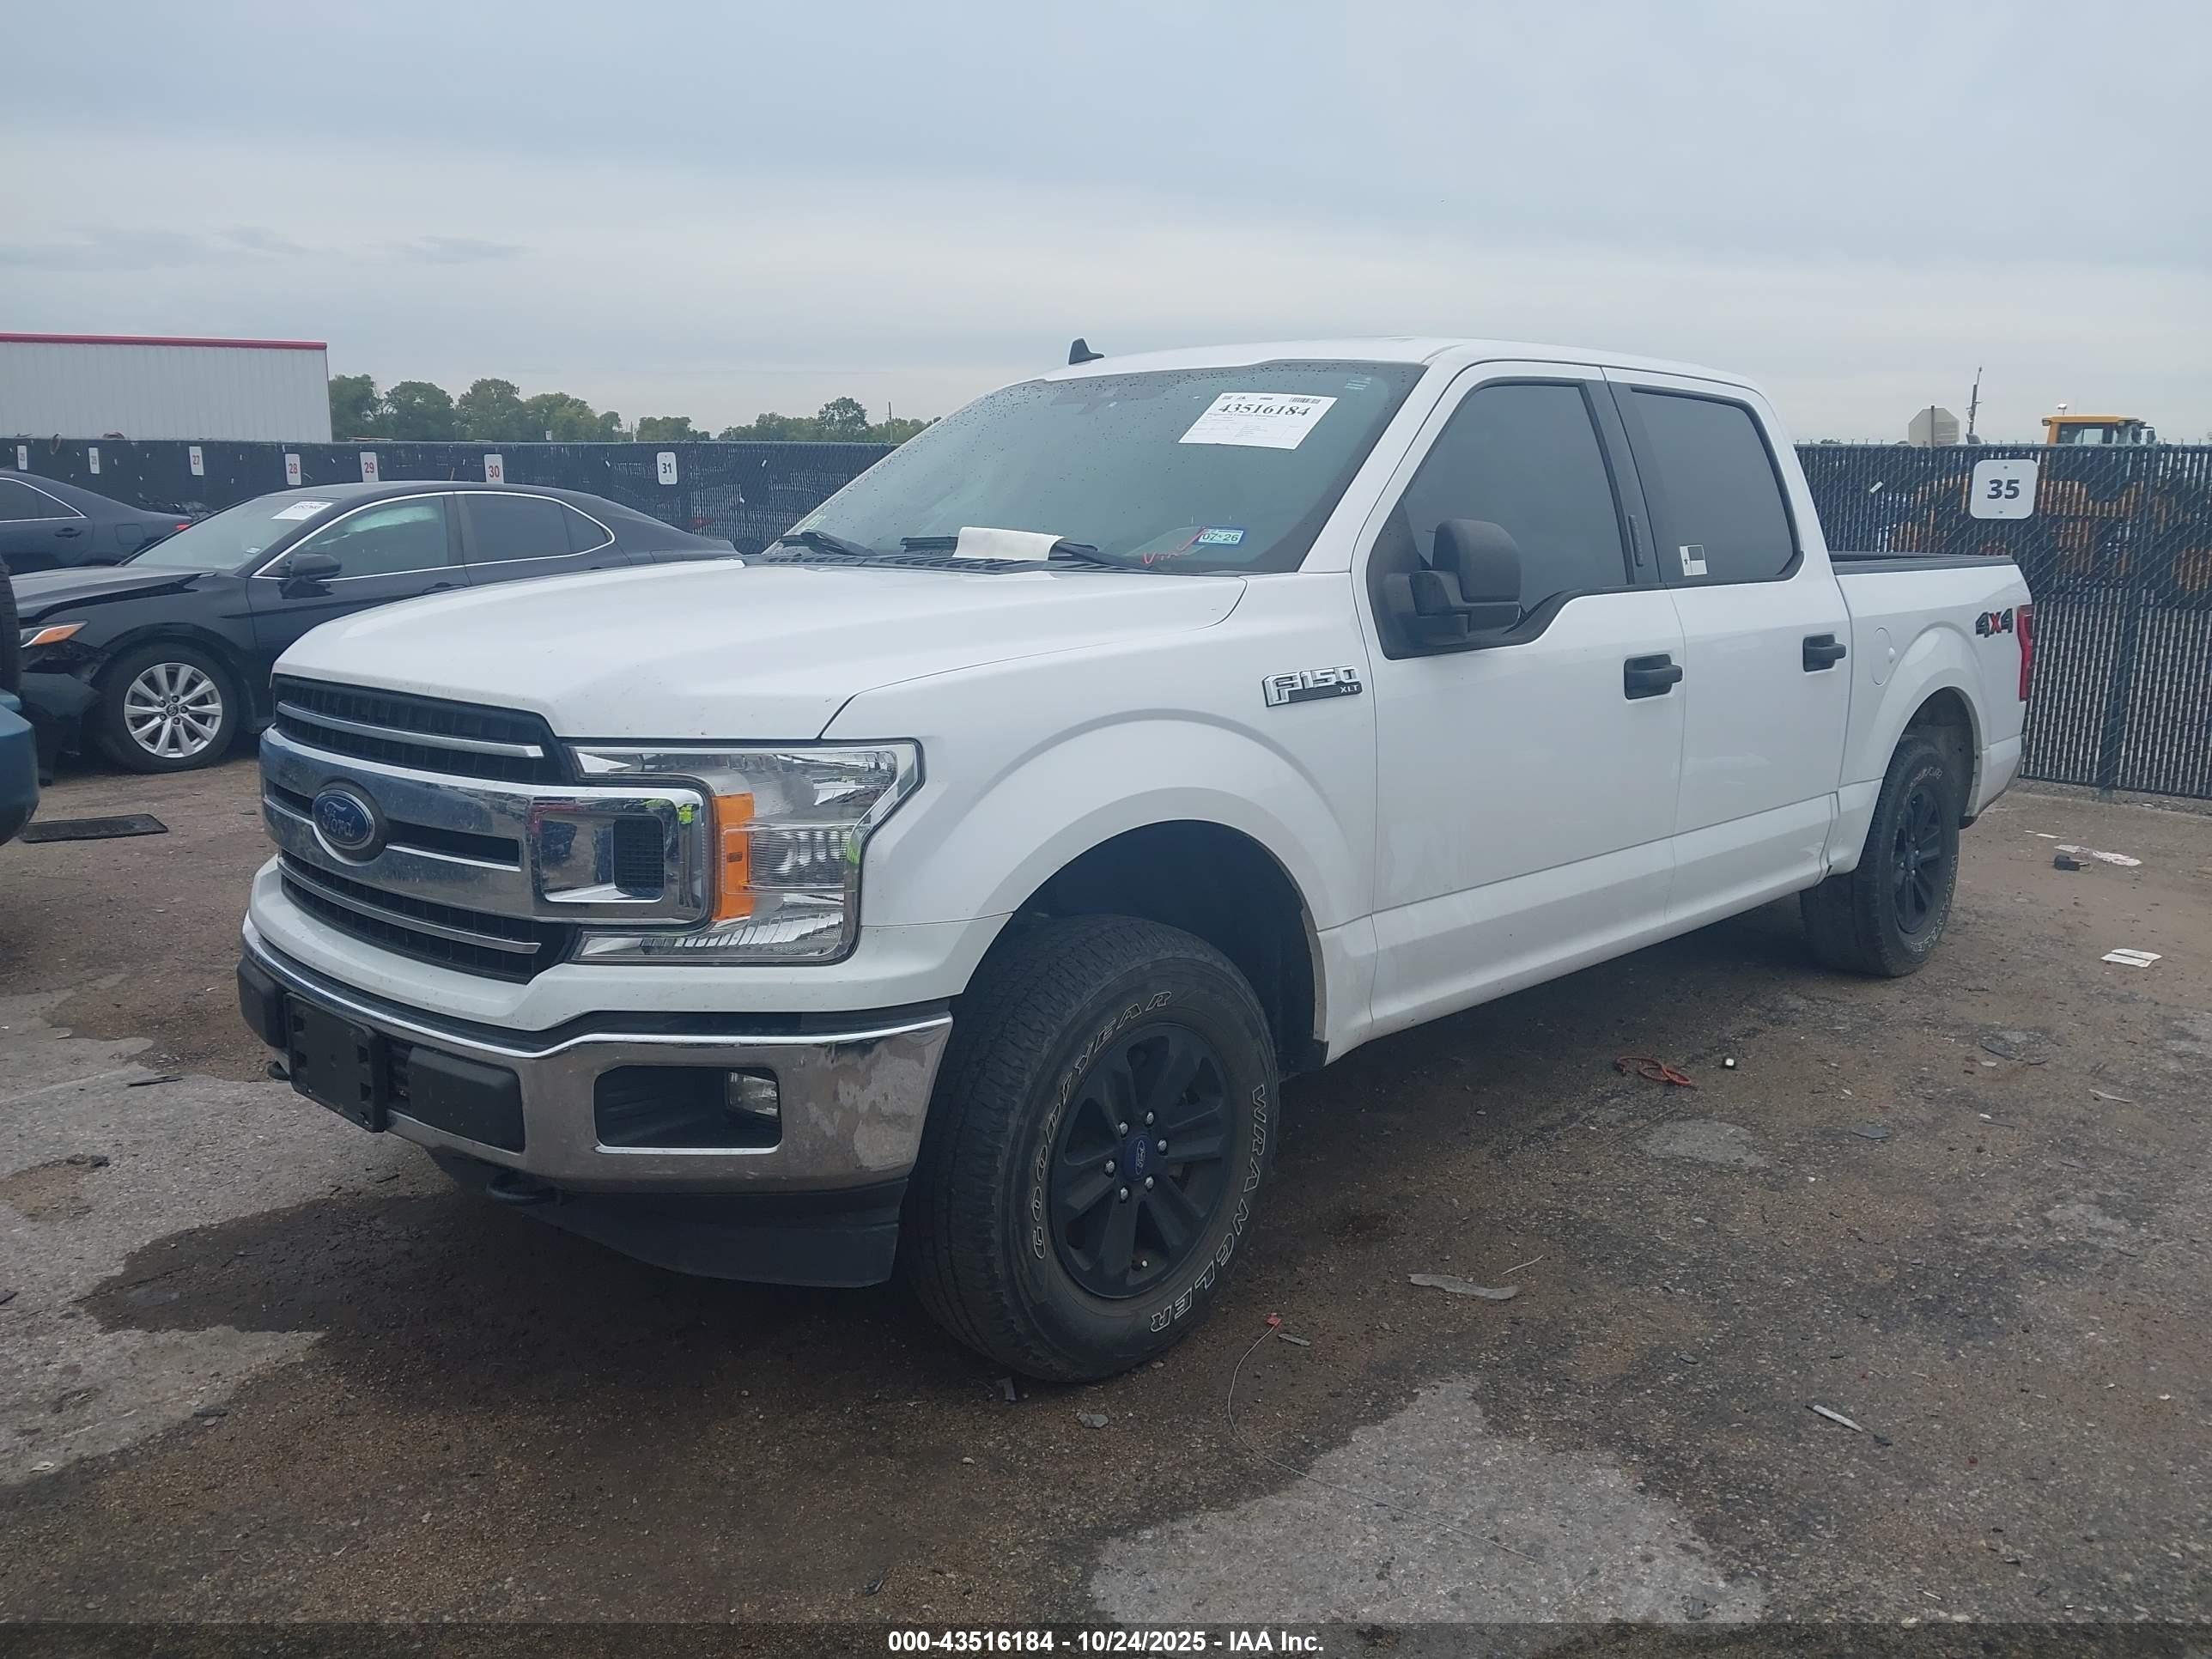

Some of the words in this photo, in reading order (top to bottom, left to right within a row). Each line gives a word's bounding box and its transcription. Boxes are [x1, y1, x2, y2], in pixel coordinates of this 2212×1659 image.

[1218, 403, 1311, 416] 43516184
[288, 463, 298, 474] 28
[364, 462, 374, 473] 29
[488, 465, 500, 477] 30
[661, 462, 672, 474] 31
[1986, 478, 2021, 500] 35
[1340, 684, 1359, 694] XLT
[1032, 990, 1173, 1260] GOODYEAR
[1149, 1084, 1267, 1334] WRANGLER
